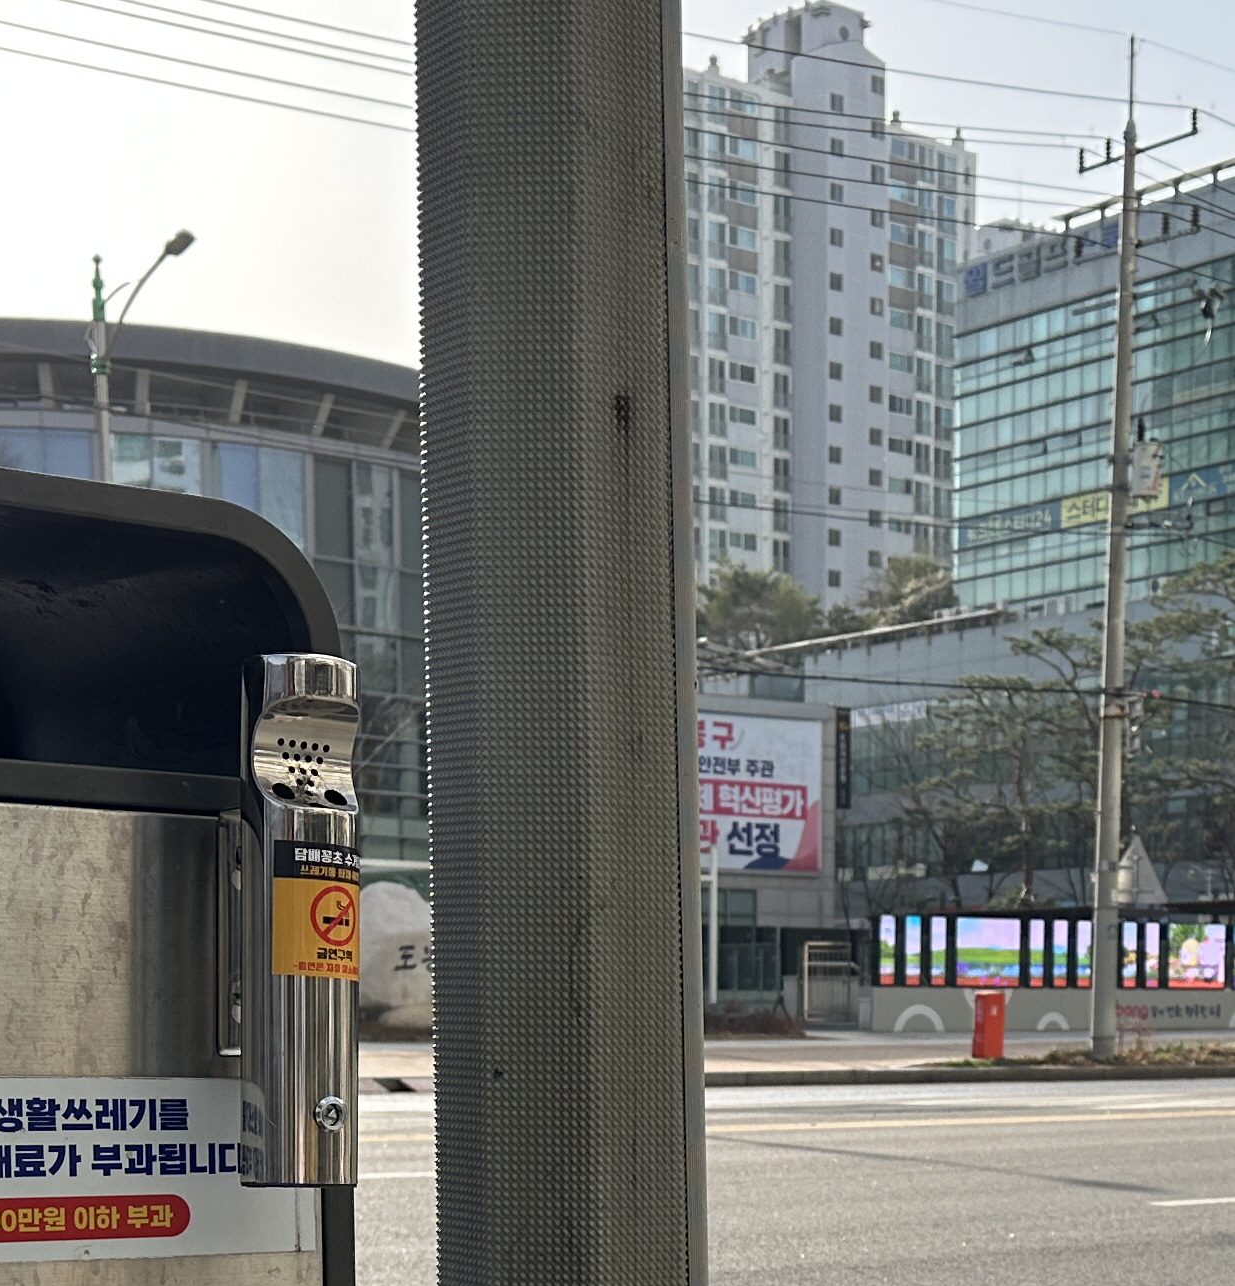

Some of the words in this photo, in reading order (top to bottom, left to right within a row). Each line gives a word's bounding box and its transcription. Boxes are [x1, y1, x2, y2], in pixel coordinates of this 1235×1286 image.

[746, 758, 775, 778] 주관
[718, 784, 805, 817] 혁신평가
[727, 821, 780, 857] 선정
[294, 847, 343, 865] 담배꽁초
[317, 947, 352, 962] 금연구역
[74, 1205, 120, 1231] 이하
[127, 1204, 173, 1229] 부과
